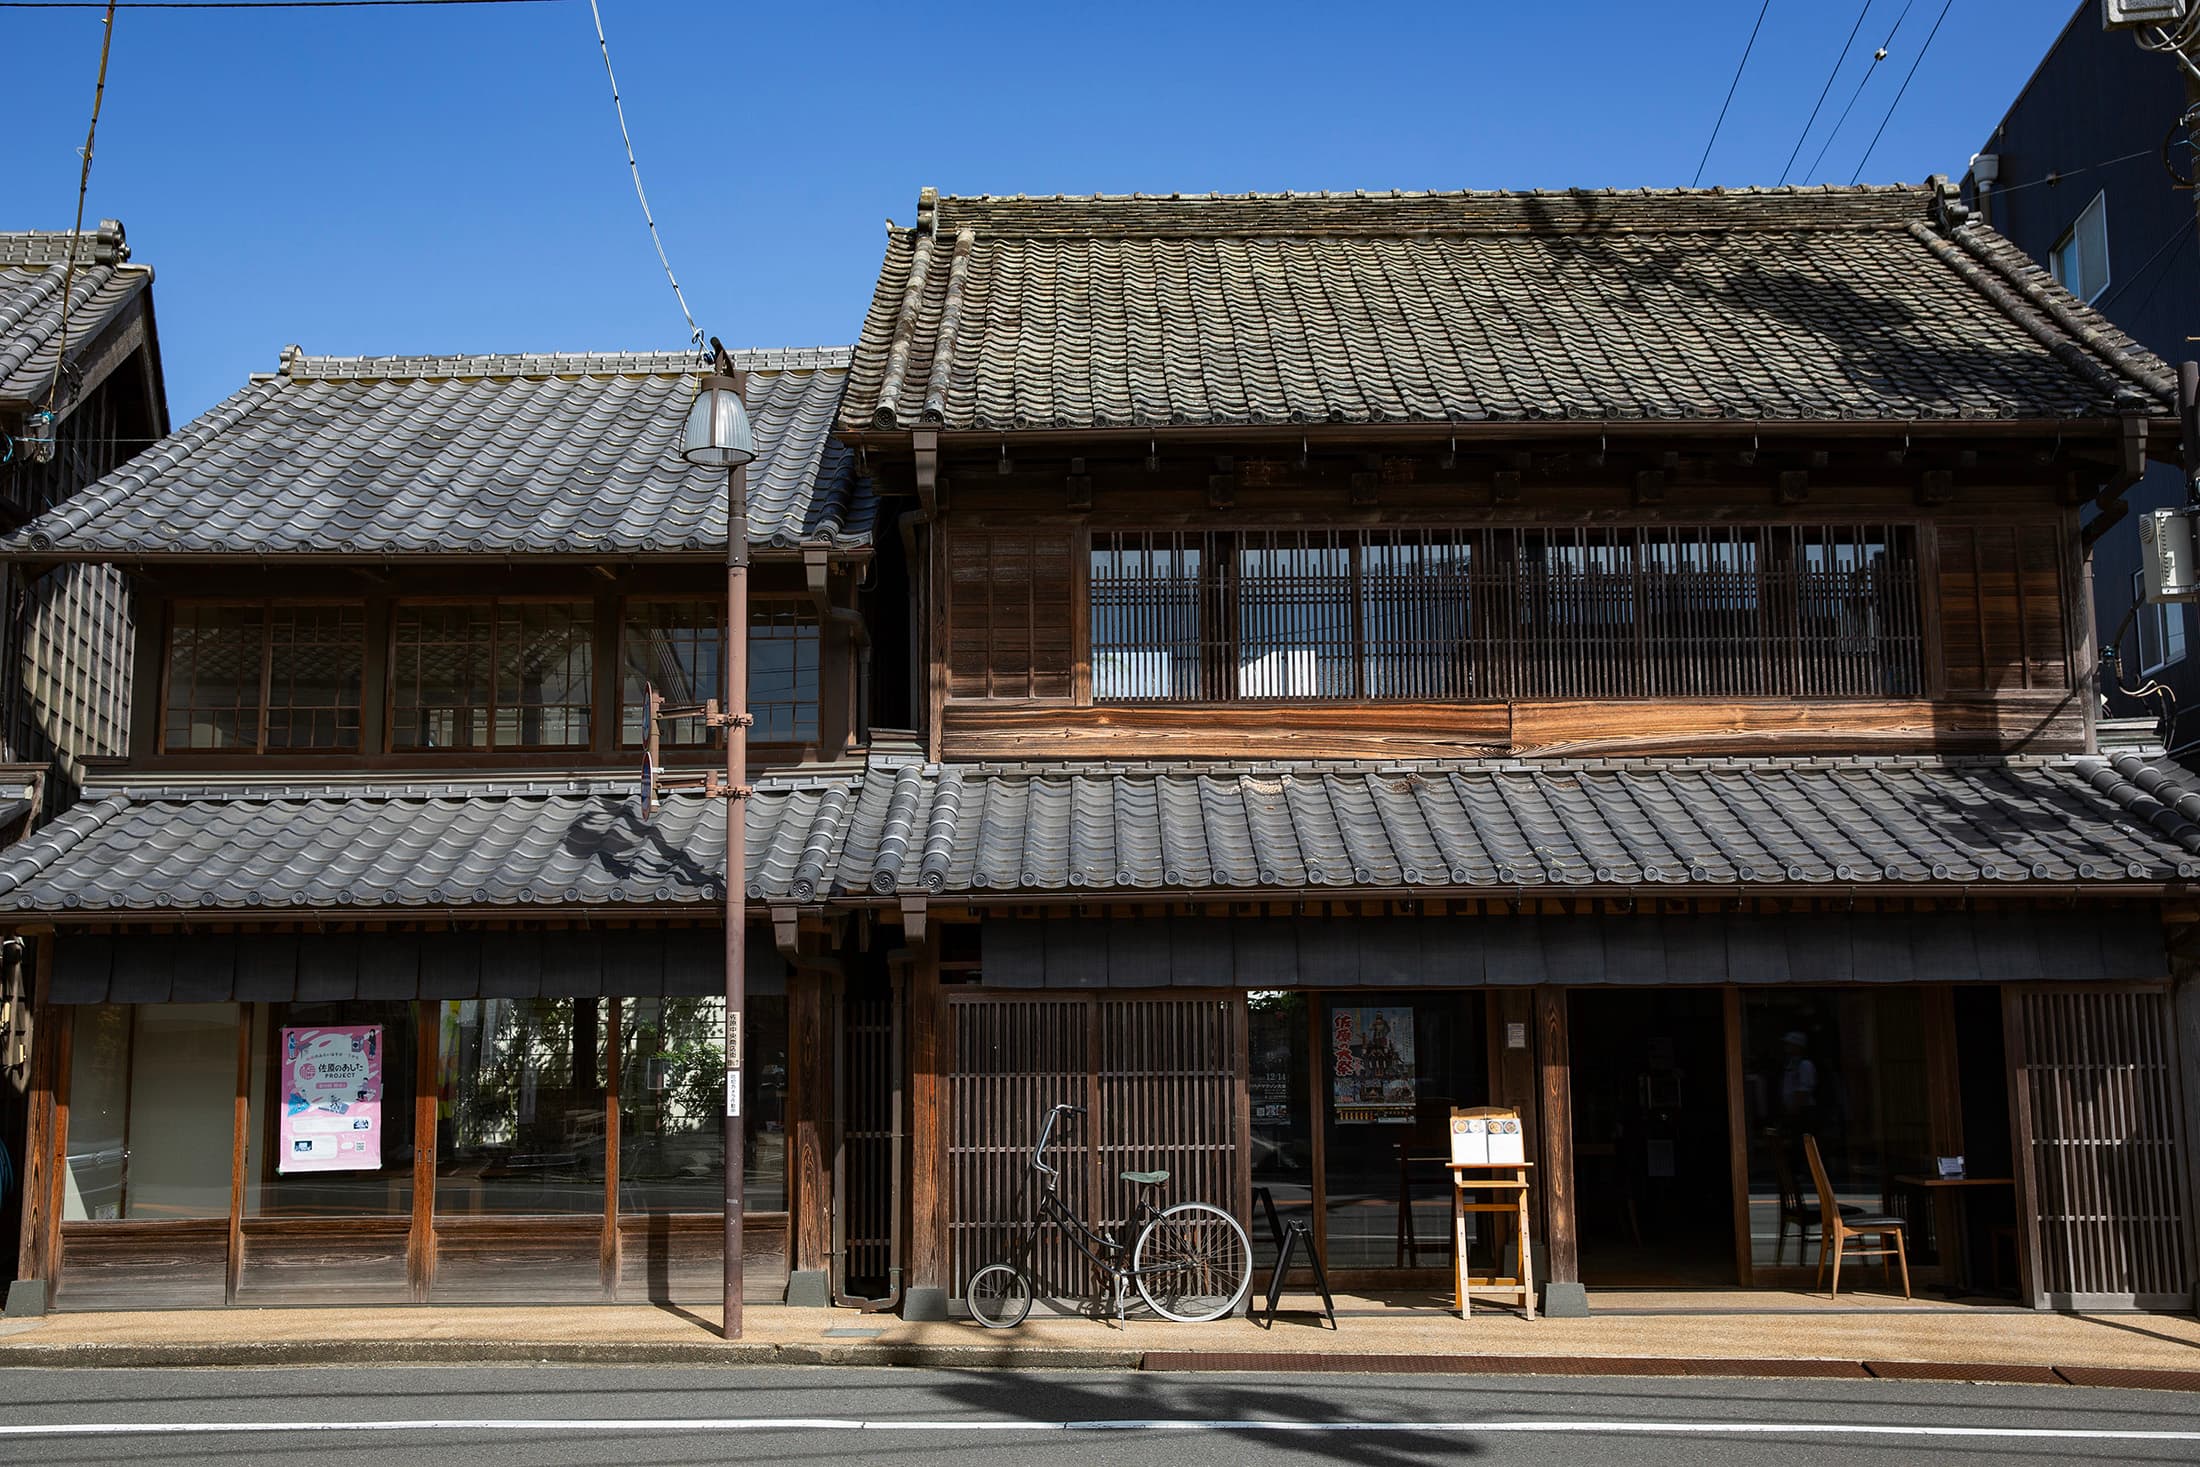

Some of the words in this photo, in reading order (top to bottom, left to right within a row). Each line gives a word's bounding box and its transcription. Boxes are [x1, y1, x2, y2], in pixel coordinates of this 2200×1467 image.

[318, 1063, 363, 1072] 佐原のあした
